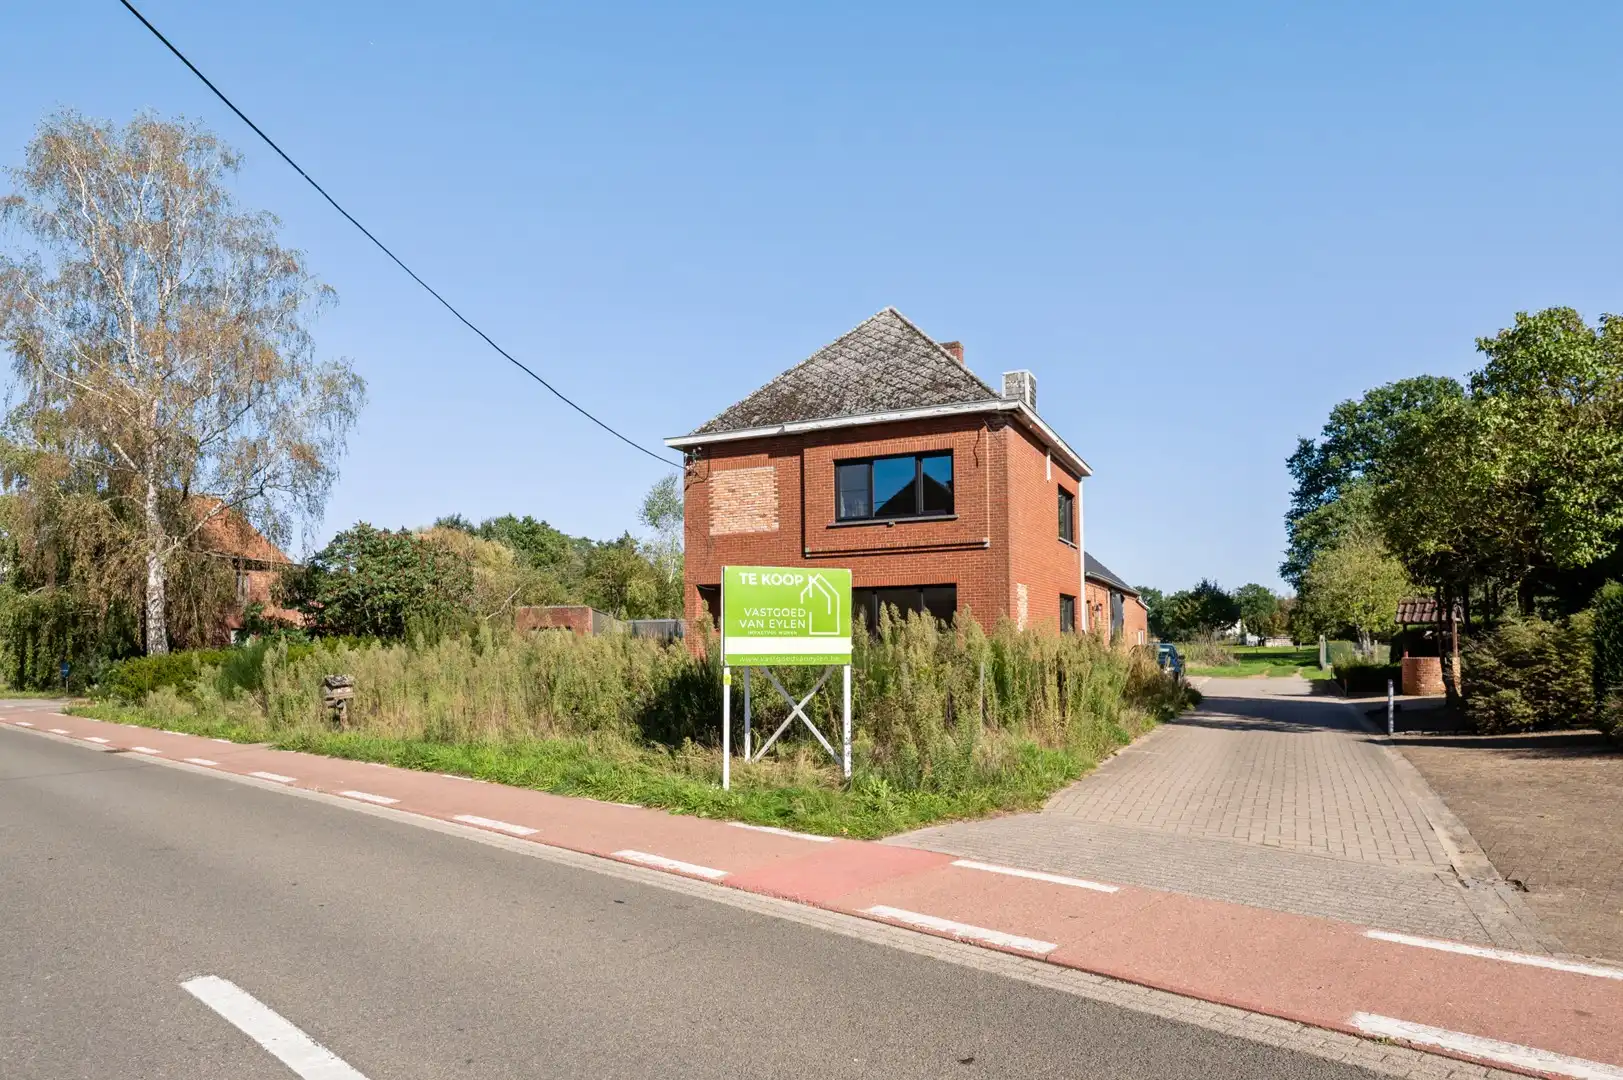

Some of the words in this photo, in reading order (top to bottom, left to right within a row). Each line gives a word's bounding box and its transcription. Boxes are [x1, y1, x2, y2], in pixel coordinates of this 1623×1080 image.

[739, 573, 757, 585] TE
[761, 574, 804, 586] KOOP
[744, 608, 806, 617] VASTGOED
[739, 619, 764, 628] VAN
[769, 619, 806, 629] EYLEN
